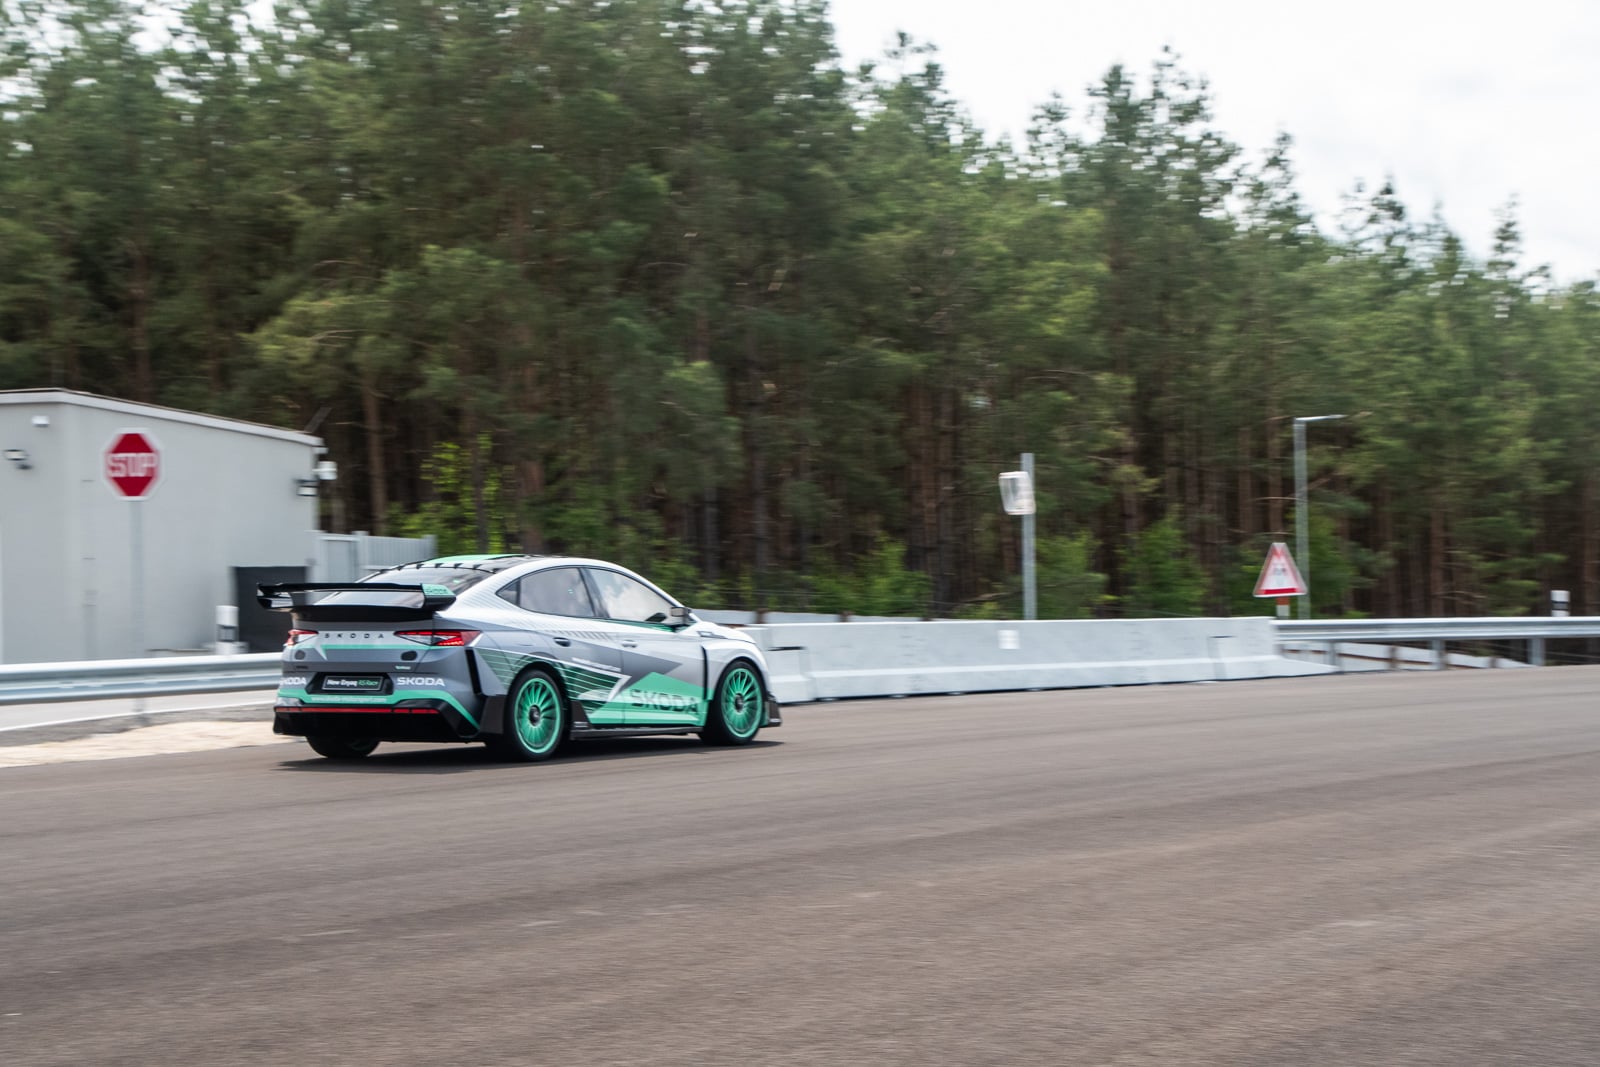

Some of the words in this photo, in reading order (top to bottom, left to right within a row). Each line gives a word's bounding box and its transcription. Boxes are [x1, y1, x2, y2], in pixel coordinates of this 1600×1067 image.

[106, 452, 158, 477] STOP
[397, 677, 445, 687] SKODA
[631, 689, 699, 712] SKODA
